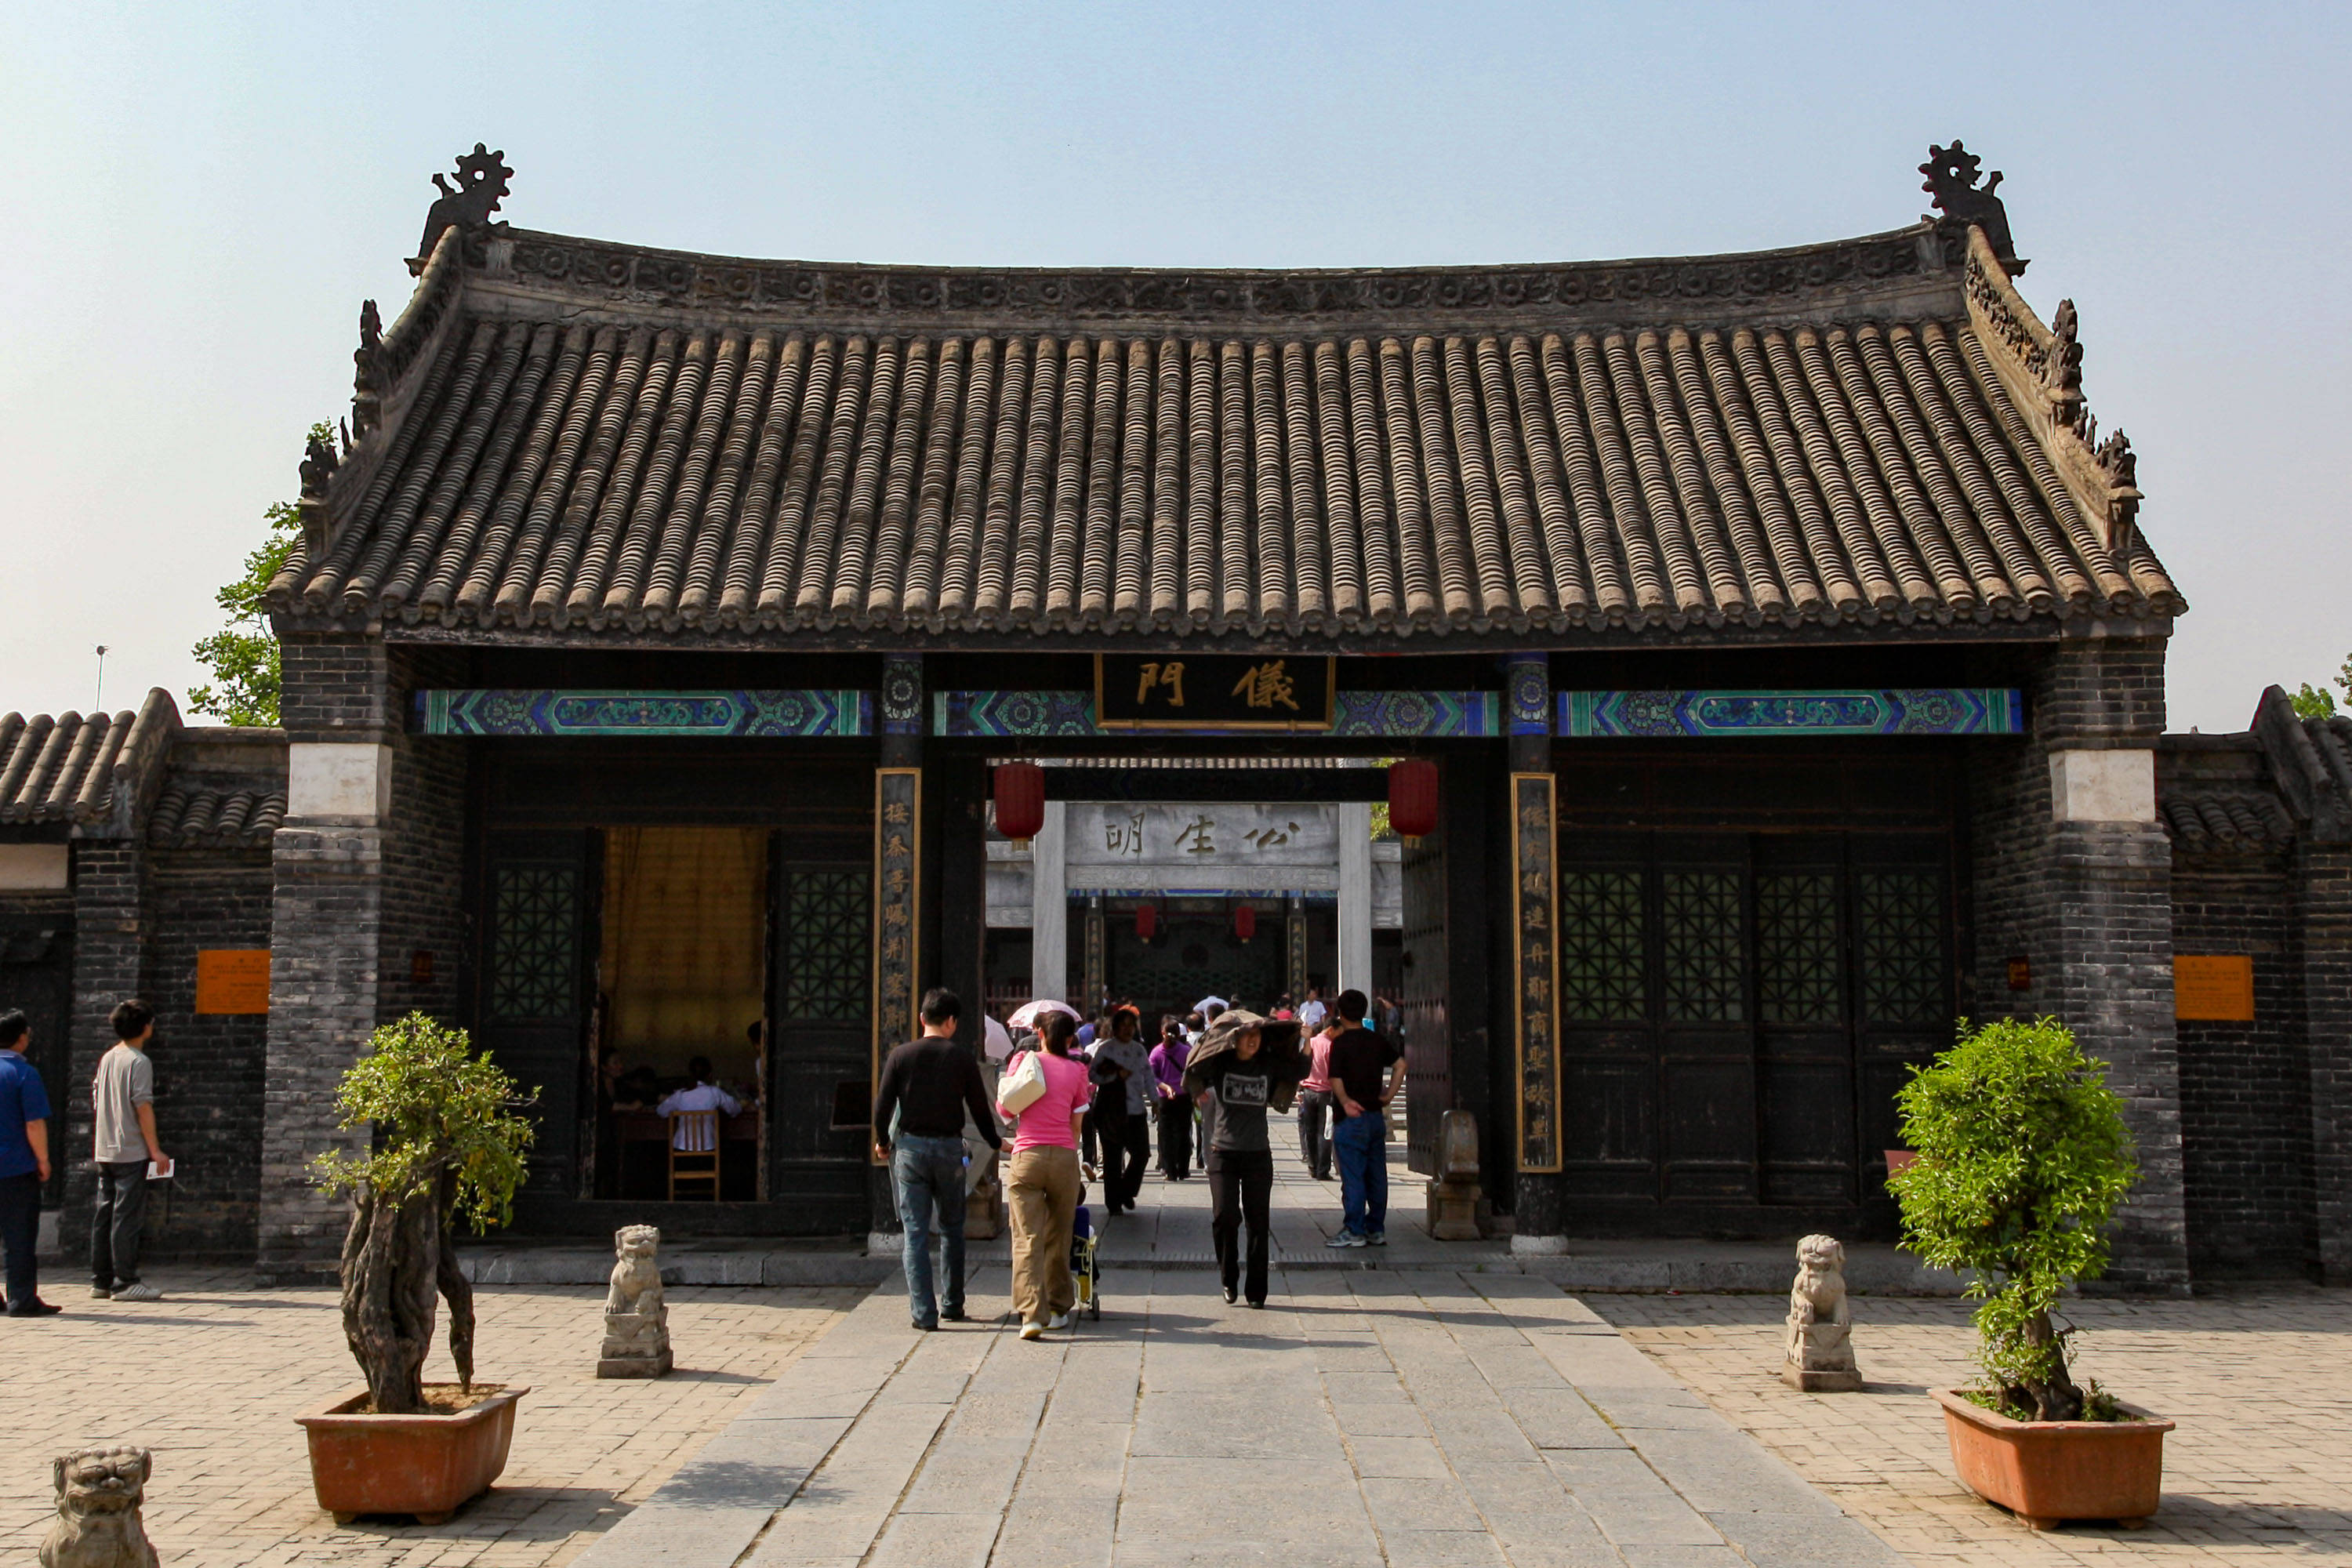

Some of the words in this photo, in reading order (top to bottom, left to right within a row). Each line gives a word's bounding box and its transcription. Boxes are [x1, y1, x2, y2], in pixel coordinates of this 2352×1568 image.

[1137, 659, 1301, 710] 儀門
[1105, 812, 1301, 856] 公生明
